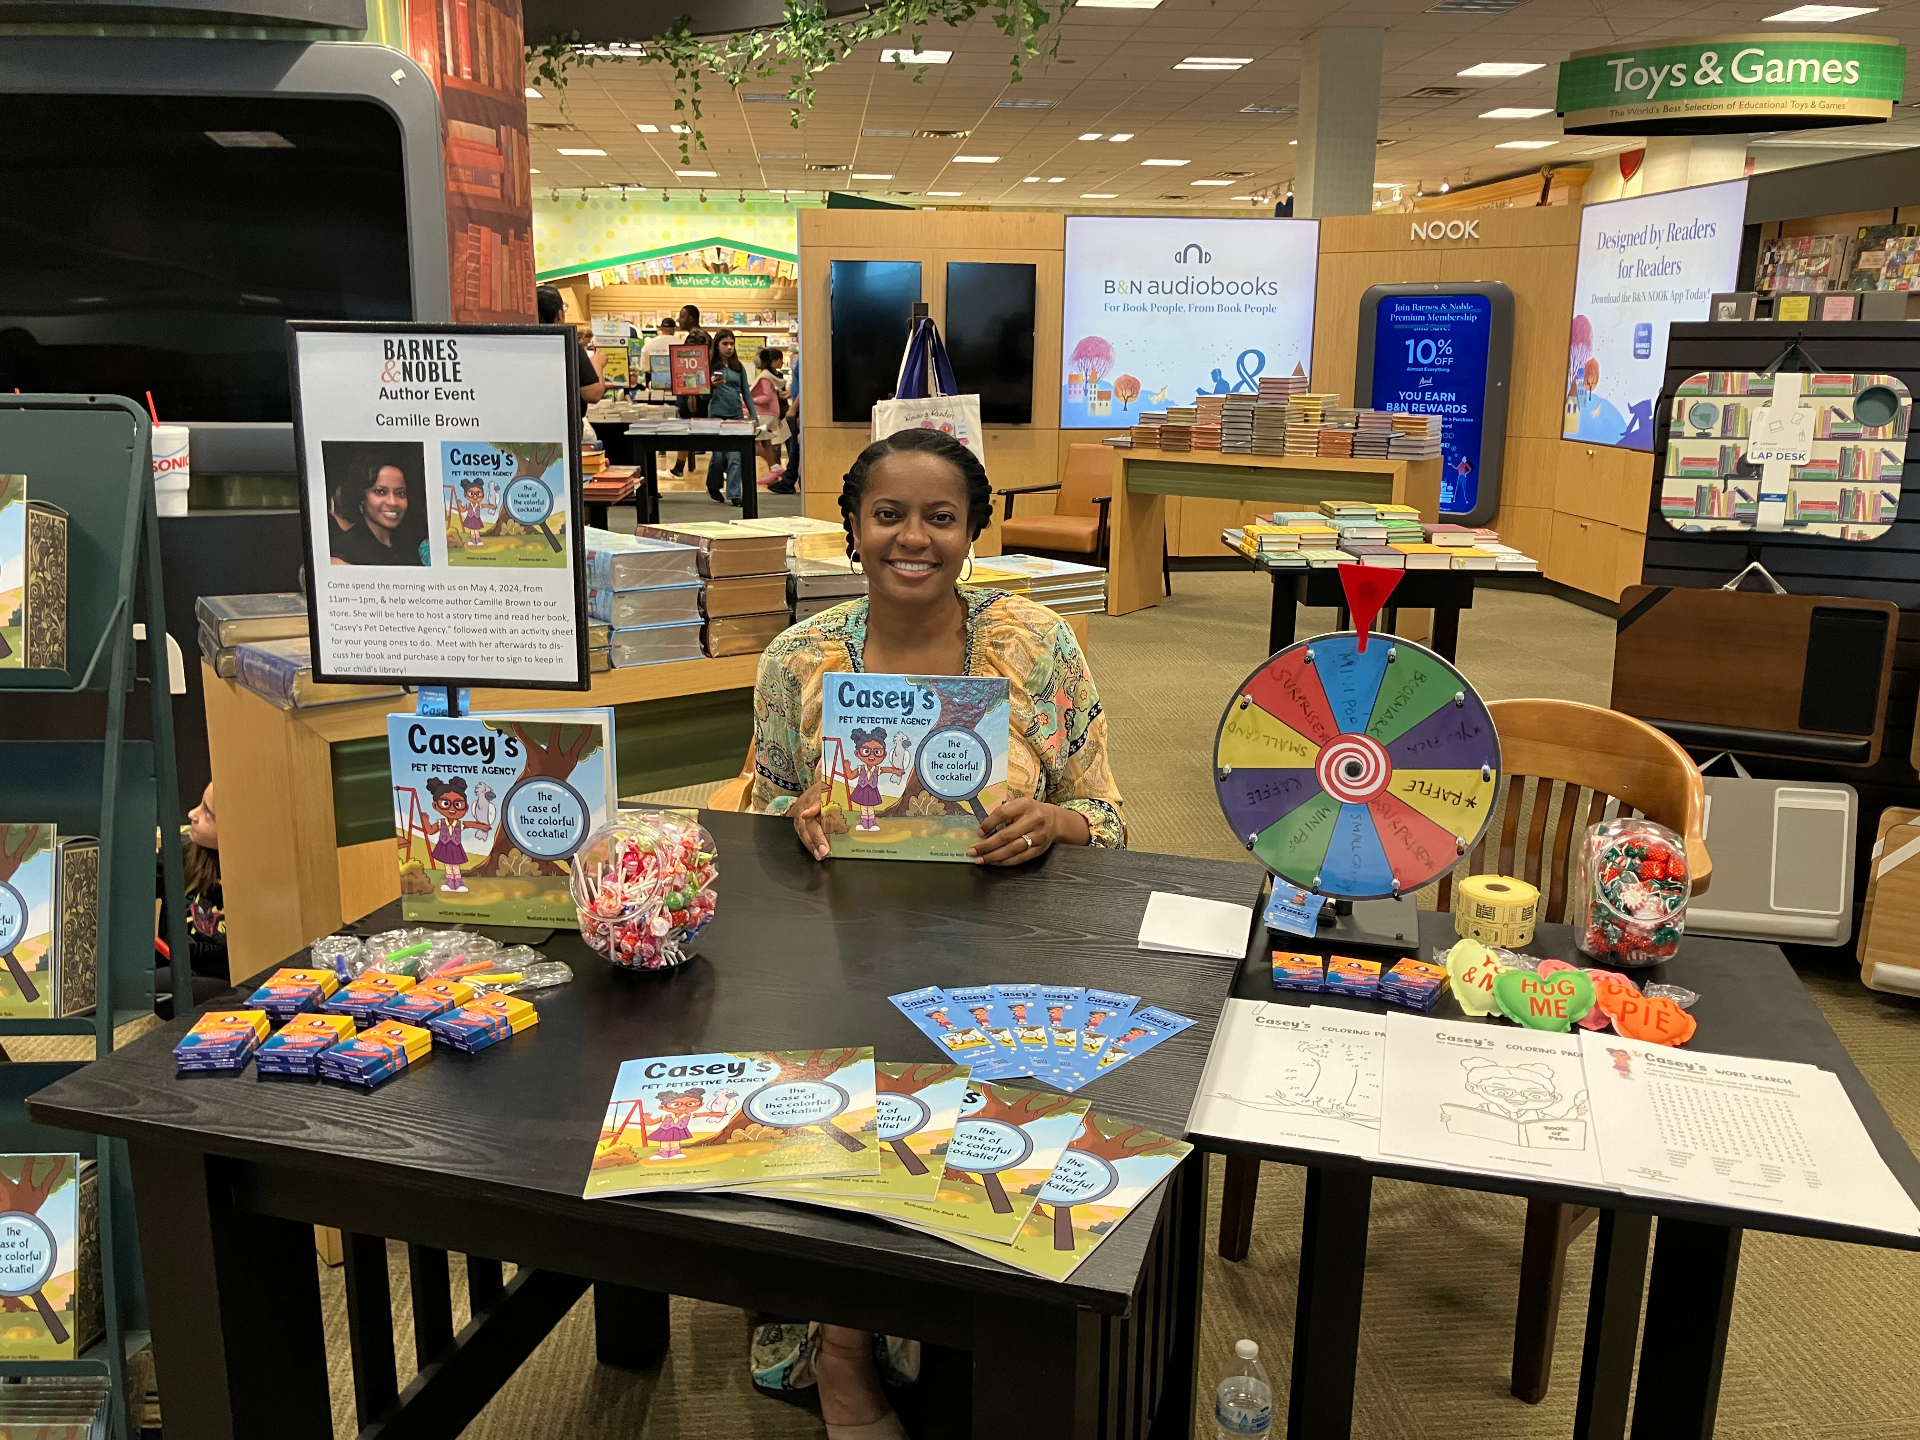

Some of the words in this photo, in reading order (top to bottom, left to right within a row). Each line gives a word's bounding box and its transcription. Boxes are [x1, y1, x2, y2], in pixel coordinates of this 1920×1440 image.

[1607, 57, 1687, 99] Toys
[1693, 51, 1723, 85] &
[1731, 48, 1860, 85] Games
[1609, 109, 1625, 118] The
[1627, 106, 1660, 116] World's
[1662, 105, 1681, 113] Best
[1684, 102, 1724, 112] Selection
[1727, 101, 1736, 110] of
[1739, 100, 1787, 110] Educational
[1790, 100, 1809, 111] Toys
[1810, 101, 1817, 109] &
[1818, 100, 1846, 110] Games
[1410, 220, 1480, 241] NOOK
[1597, 229, 1647, 254] Designed
[1649, 224, 1665, 251] by
[1666, 217, 1717, 244] Readers
[1617, 258, 1634, 280] for
[1636, 255, 1682, 278] Readers
[675, 276, 710, 286] Barnes
[710, 276, 721, 286] &
[722, 276, 753, 288] Noble,
[753, 276, 766, 286] Jr.
[1104, 279, 1142, 295] B&N
[1147, 276, 1278, 296] audiobooks
[1591, 292, 1621, 305] Download
[1621, 292, 1630, 303] the
[1648, 290, 1669, 302] NOOK
[1669, 289, 1684, 304] App
[1685, 287, 1711, 303] Today!
[1104, 303, 1120, 313] For
[1123, 303, 1148, 313] Book
[1150, 303, 1186, 315] People,
[1188, 303, 1215, 313] From
[1217, 303, 1242, 313] Book
[1244, 303, 1277, 316] People
[1394, 303, 1410, 312] Join
[1412, 303, 1439, 312] Barnes
[1390, 313, 1425, 322] Premium
[1427, 313, 1477, 323] Membership
[383, 339, 458, 360] BARNES
[1405, 339, 1453, 364] 10%
[680, 358, 698, 369] $10
[1434, 357, 1454, 365] OFF
[379, 387, 429, 400] Author
[435, 388, 475, 400] Event
[1399, 391, 1421, 401] YOU
[1425, 392, 1456, 402] EARN
[1386, 403, 1409, 412] B&N
[1411, 403, 1468, 414] REWARDS
[376, 414, 430, 426] Camille
[436, 414, 479, 427] Brown
[450, 448, 514, 470] Casey's
[1751, 452, 1773, 460] LAP
[1776, 453, 1806, 461] DESK
[327, 581, 350, 590] Come
[352, 582, 375, 591] spend
[377, 582, 390, 590] the
[392, 583, 426, 592] morning
[427, 583, 445, 591] with
[470, 584, 488, 593] May
[489, 584, 497, 592] 4,
[499, 584, 522, 593] 2024,
[523, 584, 543, 592] from
[380, 596, 387, 604] &
[389, 596, 406, 605] help
[408, 597, 444, 605] welcome
[474, 598, 503, 606] Camille
[505, 598, 531, 606] Brown
[334, 666, 351, 674] your
[353, 665, 377, 673] child's
[838, 680, 934, 716] Casey's
[838, 716, 853, 724] PET
[856, 716, 898, 725] DETECTIVE
[900, 717, 931, 726] AGENCY
[408, 723, 519, 765] Casey's
[948, 739, 960, 748] the
[938, 750, 956, 759] case
[958, 750, 968, 759] of
[411, 763, 428, 773] PET
[431, 763, 478, 775] DETECTIVE
[481, 765, 516, 776] AGENCY
[931, 761, 944, 770] the
[946, 760, 979, 771] colorful
[935, 772, 972, 782] cockatiel
[537, 791, 553, 802] the
[527, 804, 548, 814] case
[550, 803, 561, 814] of
[520, 815, 535, 826] the
[537, 815, 575, 828] colorful
[526, 828, 568, 839] cockatiel
[1521, 978, 1575, 996] HUG
[902, 994, 944, 1008] Casey's
[952, 993, 995, 1002] Casey's
[1087, 996, 1130, 1008] Casey's
[1530, 997, 1568, 1019] ME
[1139, 1012, 1179, 1030] Casey's
[1621, 1000, 1669, 1034] PIE
[1255, 1016, 1311, 1029] Casey's
[1322, 1026, 1370, 1036] COLORING
[1435, 1032, 1495, 1048] Casey's
[1505, 1043, 1557, 1055] COLORING
[644, 1059, 772, 1079] Casey's
[1644, 1052, 1708, 1072] Casey's
[1715, 1068, 1747, 1078] WORD
[1751, 1074, 1793, 1085] SEARCH
[666, 1079, 722, 1088] DETECTIVE
[725, 1077, 767, 1085] AGENCY
[790, 1087, 806, 1095] the
[786, 1099, 831, 1109] colorful
[771, 1107, 822, 1116] cockatiel
[959, 1133, 986, 1142] case
[979, 1127, 996, 1136] the
[948, 1147, 998, 1162] cockatiel
[966, 1142, 1012, 1156] colorful
[6, 1226, 21, 1237] the
[19, 1238, 29, 1249] of
[5, 1250, 42, 1262] colorful
